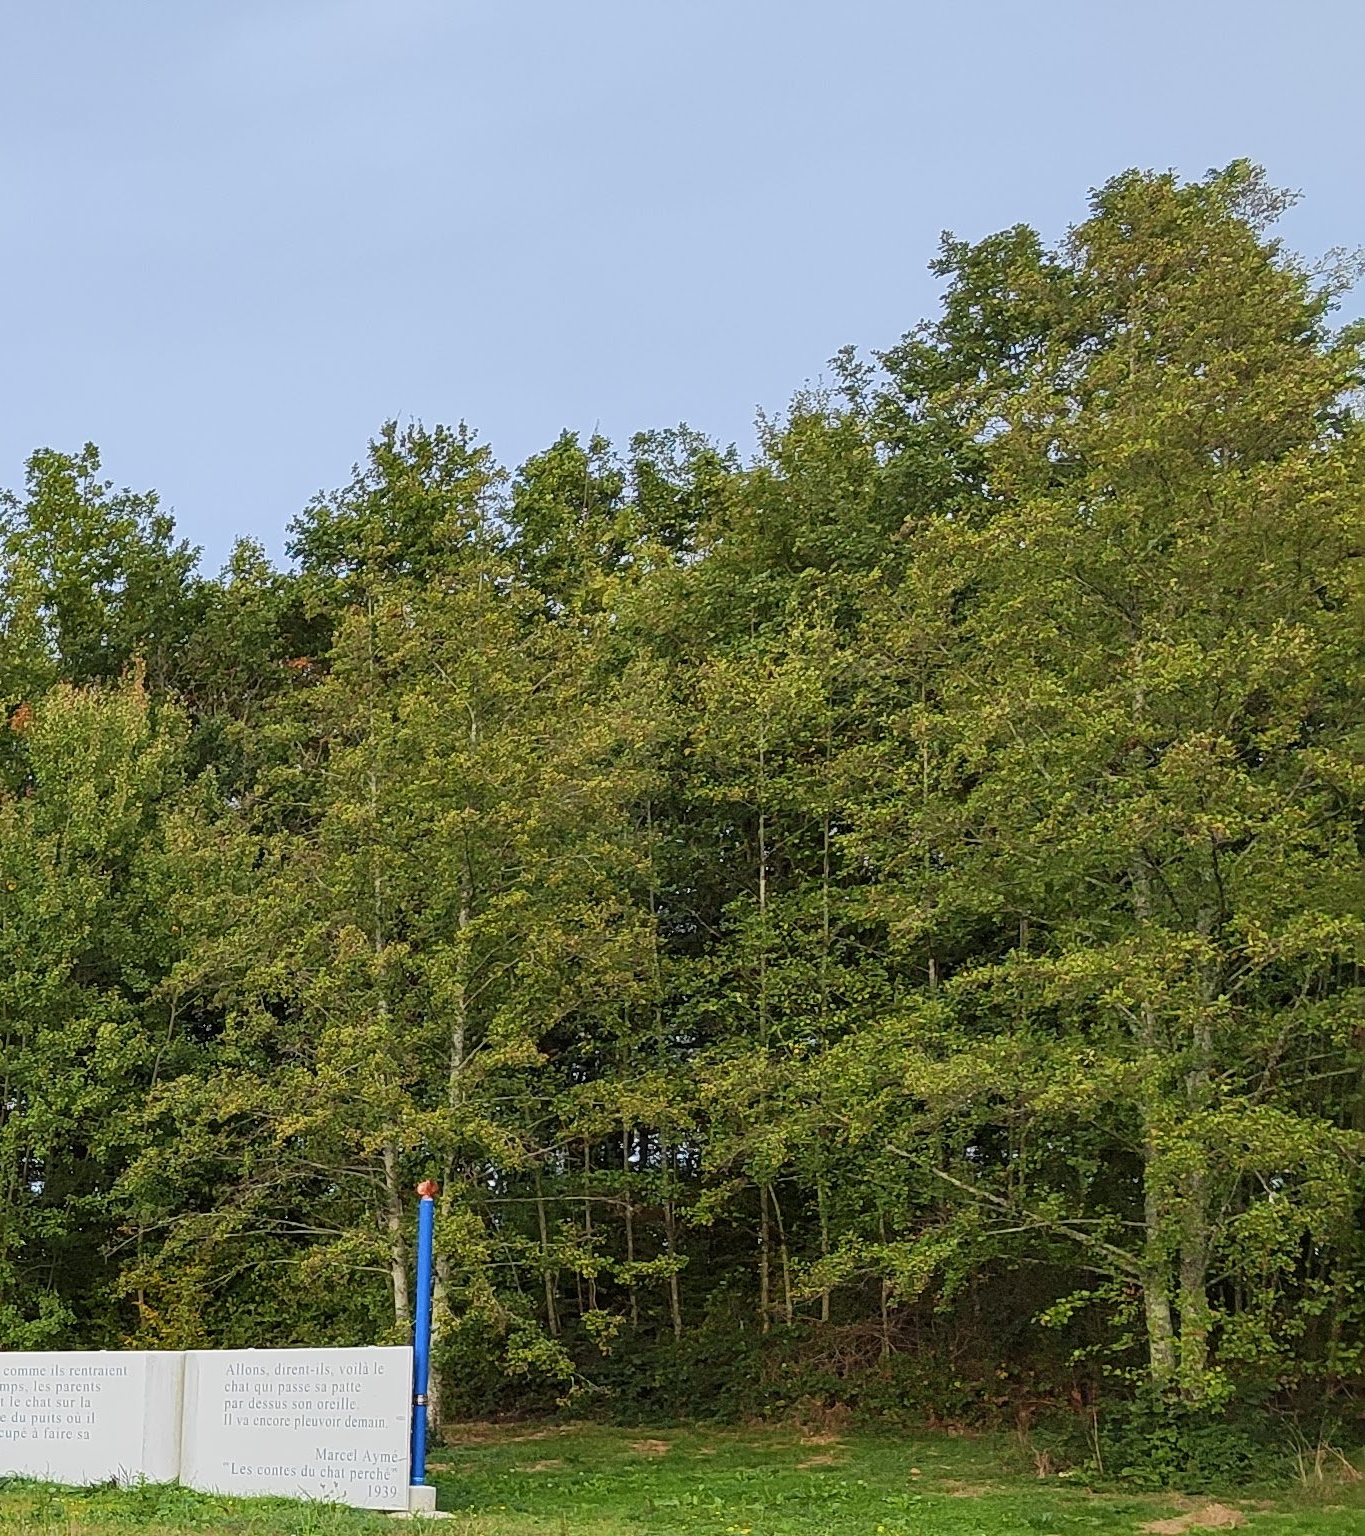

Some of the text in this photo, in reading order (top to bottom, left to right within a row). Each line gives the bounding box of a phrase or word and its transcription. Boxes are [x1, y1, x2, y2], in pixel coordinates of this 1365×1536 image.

[4, 1367, 46, 1376] comme
[51, 1365, 64, 1376] ils
[69, 1366, 127, 1376] rentraient
[226, 1362, 384, 1376] Allons, dirent-ils, voilà le
[34, 1381, 51, 1392] les
[56, 1382, 101, 1394] parents
[224, 1380, 361, 1395] chat qui passe sa patte
[10, 1396, 20, 1407] le
[26, 1397, 51, 1407] chat
[56, 1398, 75, 1407] sur
[80, 1396, 91, 1408] la
[224, 1398, 359, 1412] par dessus son oreille.
[11, 1412, 26, 1423] du
[31, 1413, 61, 1425] puits
[67, 1412, 81, 1423] où
[87, 1412, 95, 1423] il
[224, 1413, 388, 1429] Il va encore pleuvoir demain.
[32, 1427, 38, 1439] à
[44, 1427, 72, 1439] faire
[77, 1430, 90, 1440] sa
[316, 1448, 398, 1465] Marcel Aymé
[257, 1466, 296, 1476] contes
[301, 1465, 315, 1477] du
[320, 1466, 344, 1478] chat
[368, 1485, 397, 1498] 1939
